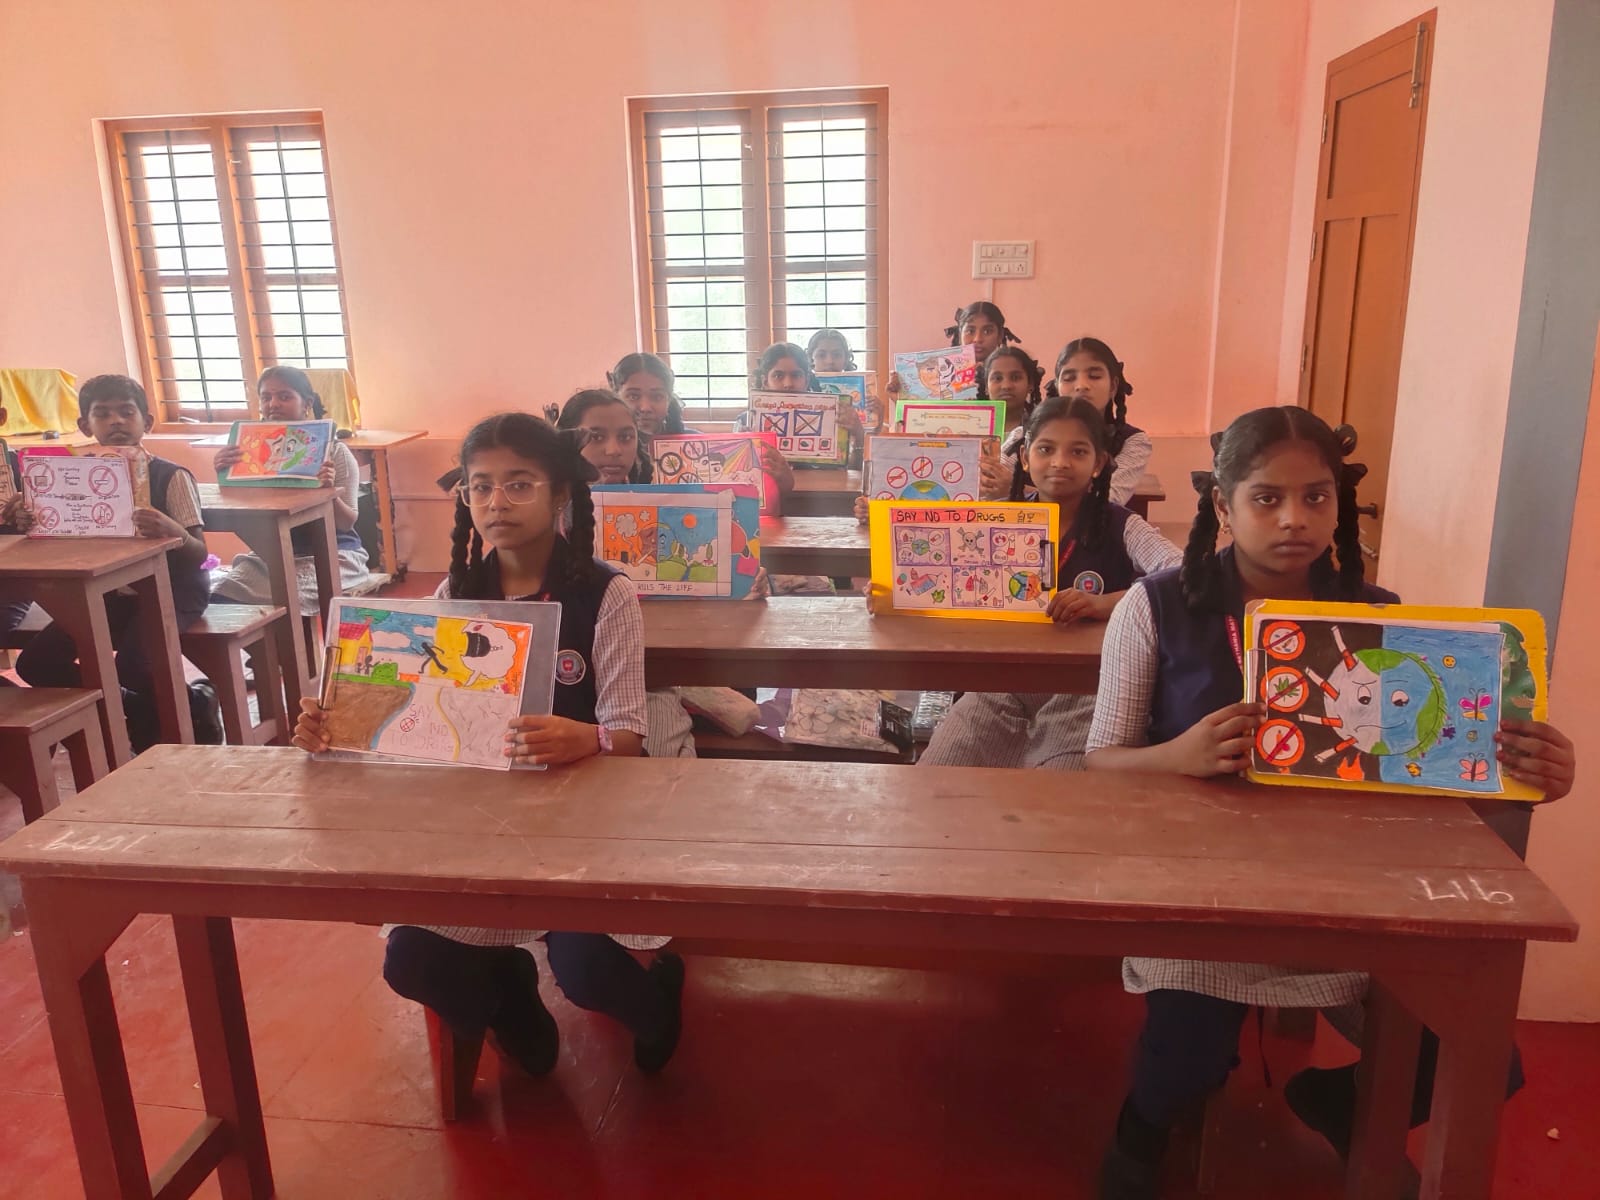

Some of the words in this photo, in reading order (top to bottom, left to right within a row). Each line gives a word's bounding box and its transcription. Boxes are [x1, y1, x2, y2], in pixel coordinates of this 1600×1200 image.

[897, 510, 917, 522] SAY
[925, 510, 940, 522] NO
[967, 509, 1006, 522] DRUGS
[658, 583, 672, 591] THE
[409, 704, 433, 718] SAY
[430, 722, 448, 736] NO
